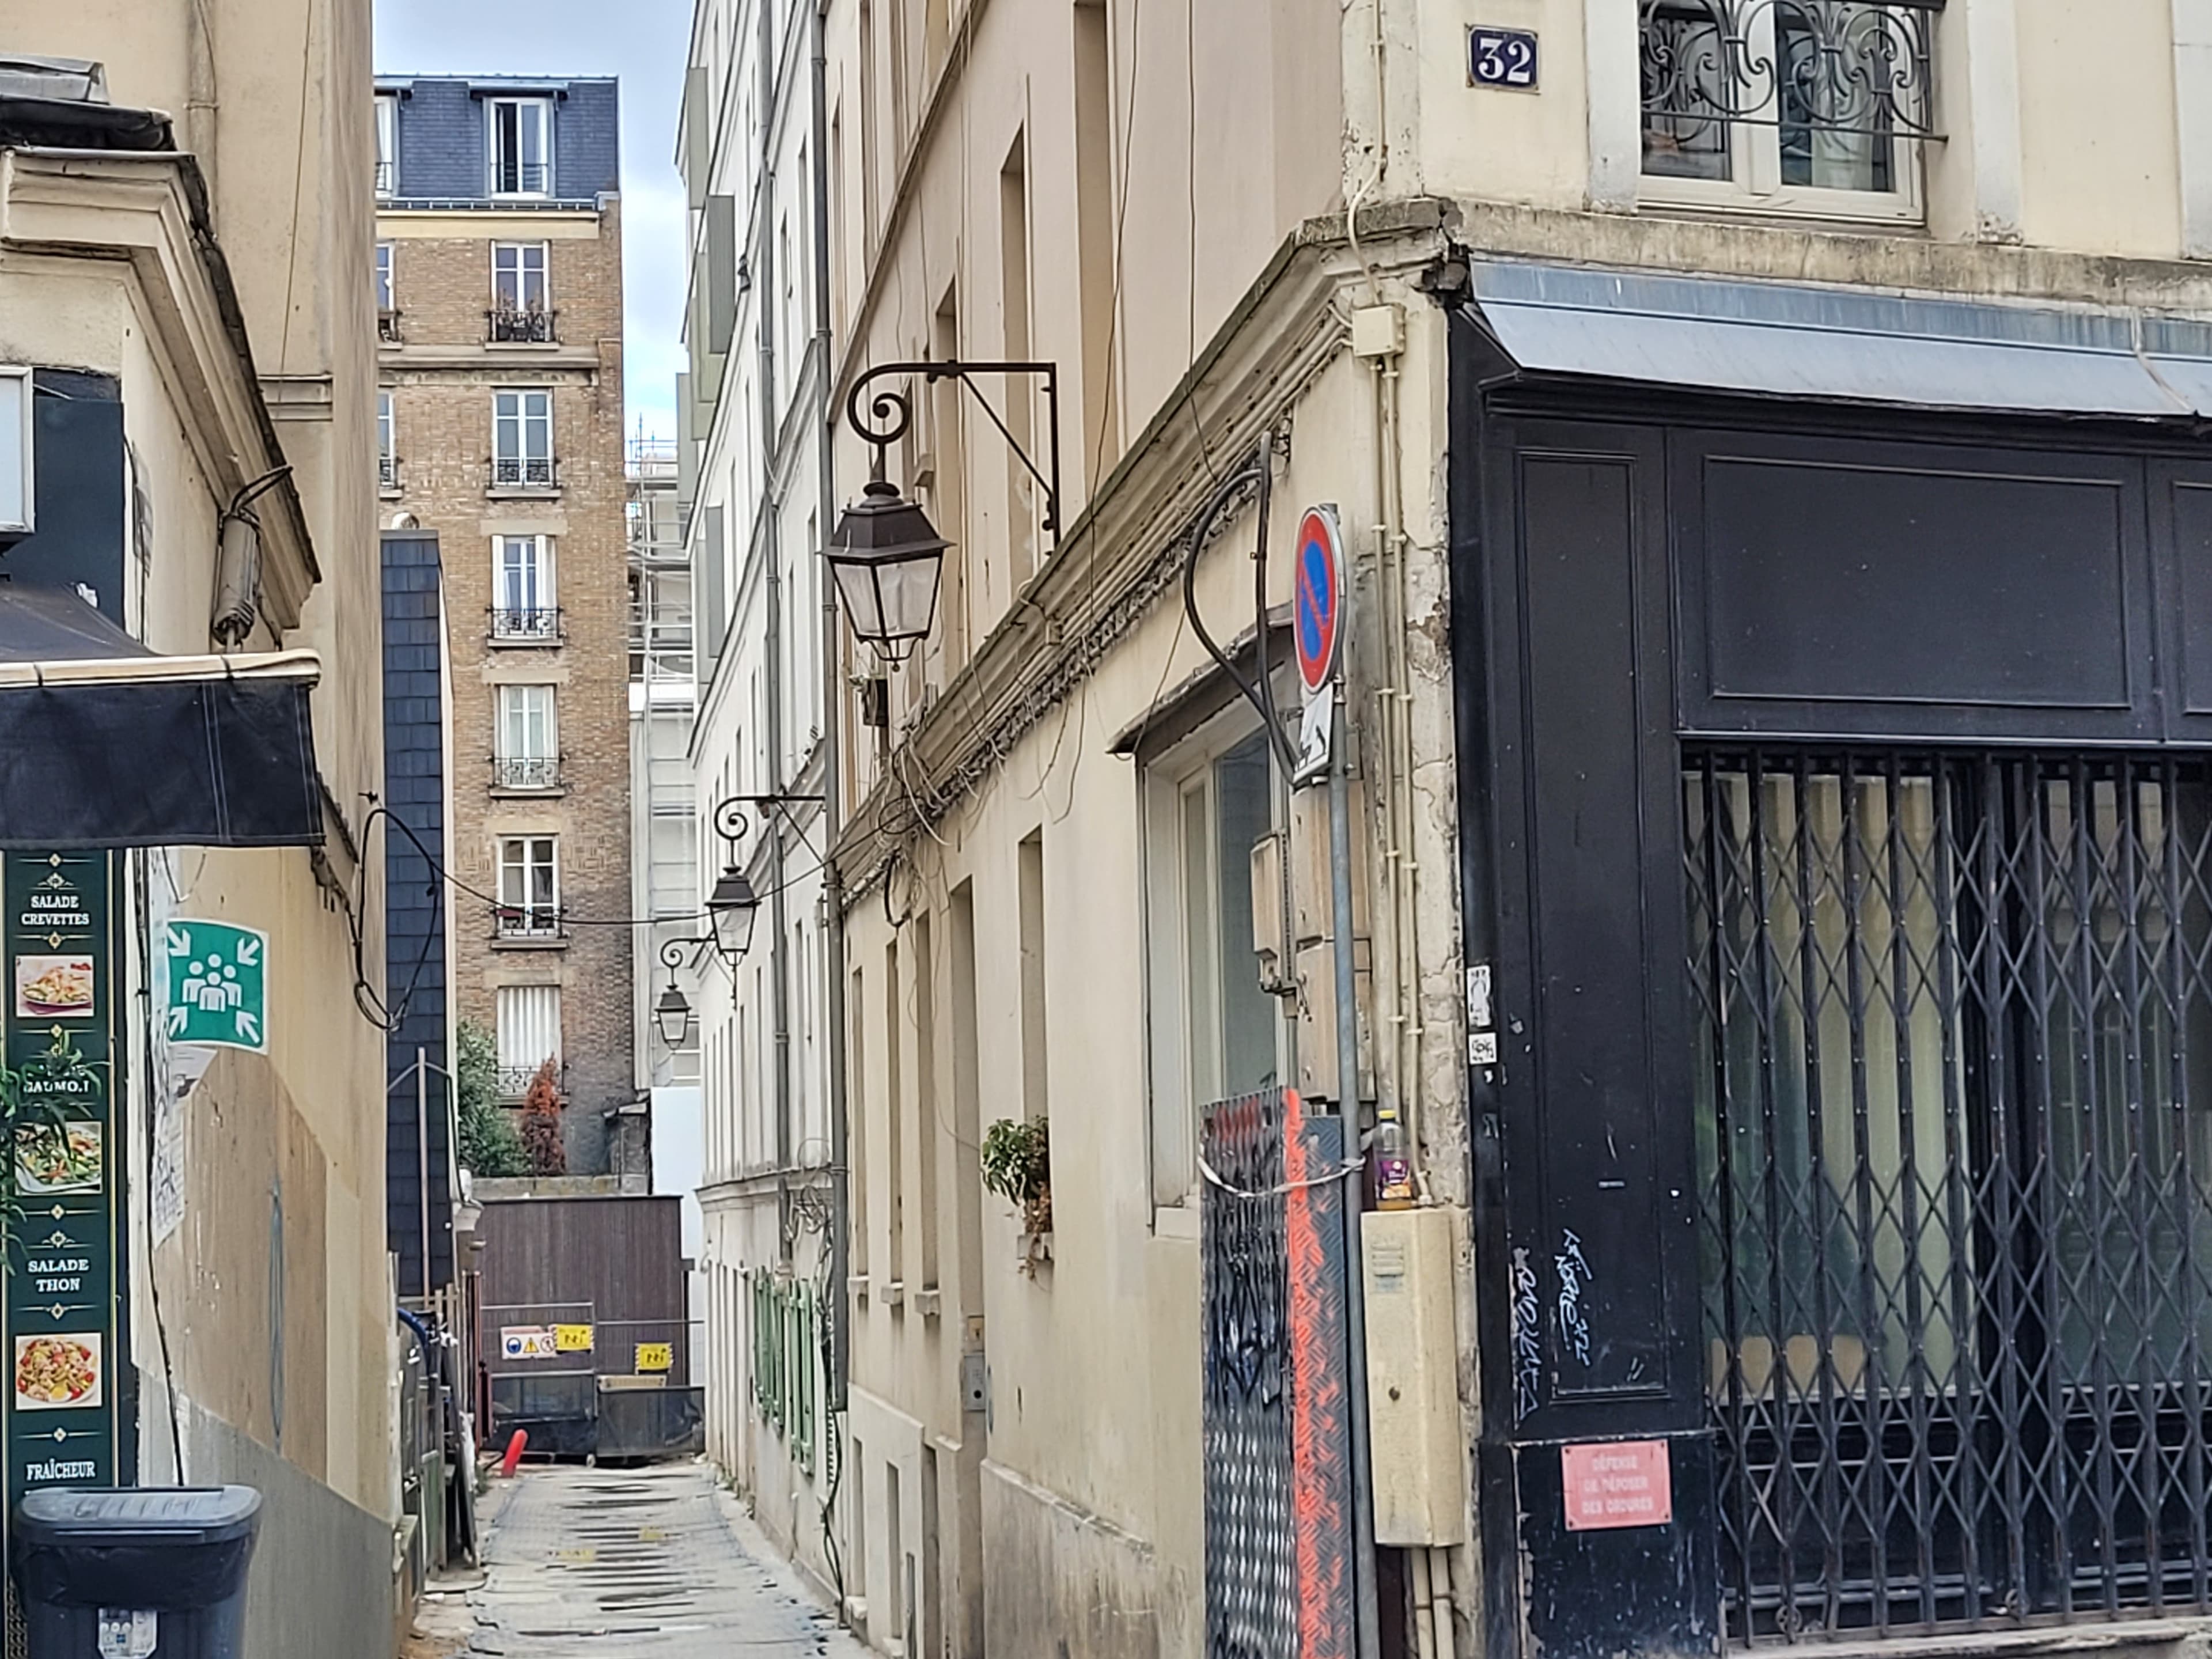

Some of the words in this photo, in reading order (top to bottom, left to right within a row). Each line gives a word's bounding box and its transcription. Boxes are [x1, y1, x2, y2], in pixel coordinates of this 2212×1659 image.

[1478, 37, 1531, 84] 32
[31, 895, 79, 908] SALADE
[21, 913, 90, 925] CREVETTES
[27, 1259, 89, 1272] SALADE
[35, 1277, 81, 1292] THON
[26, 1457, 96, 1481] FRAÎCHEUR
